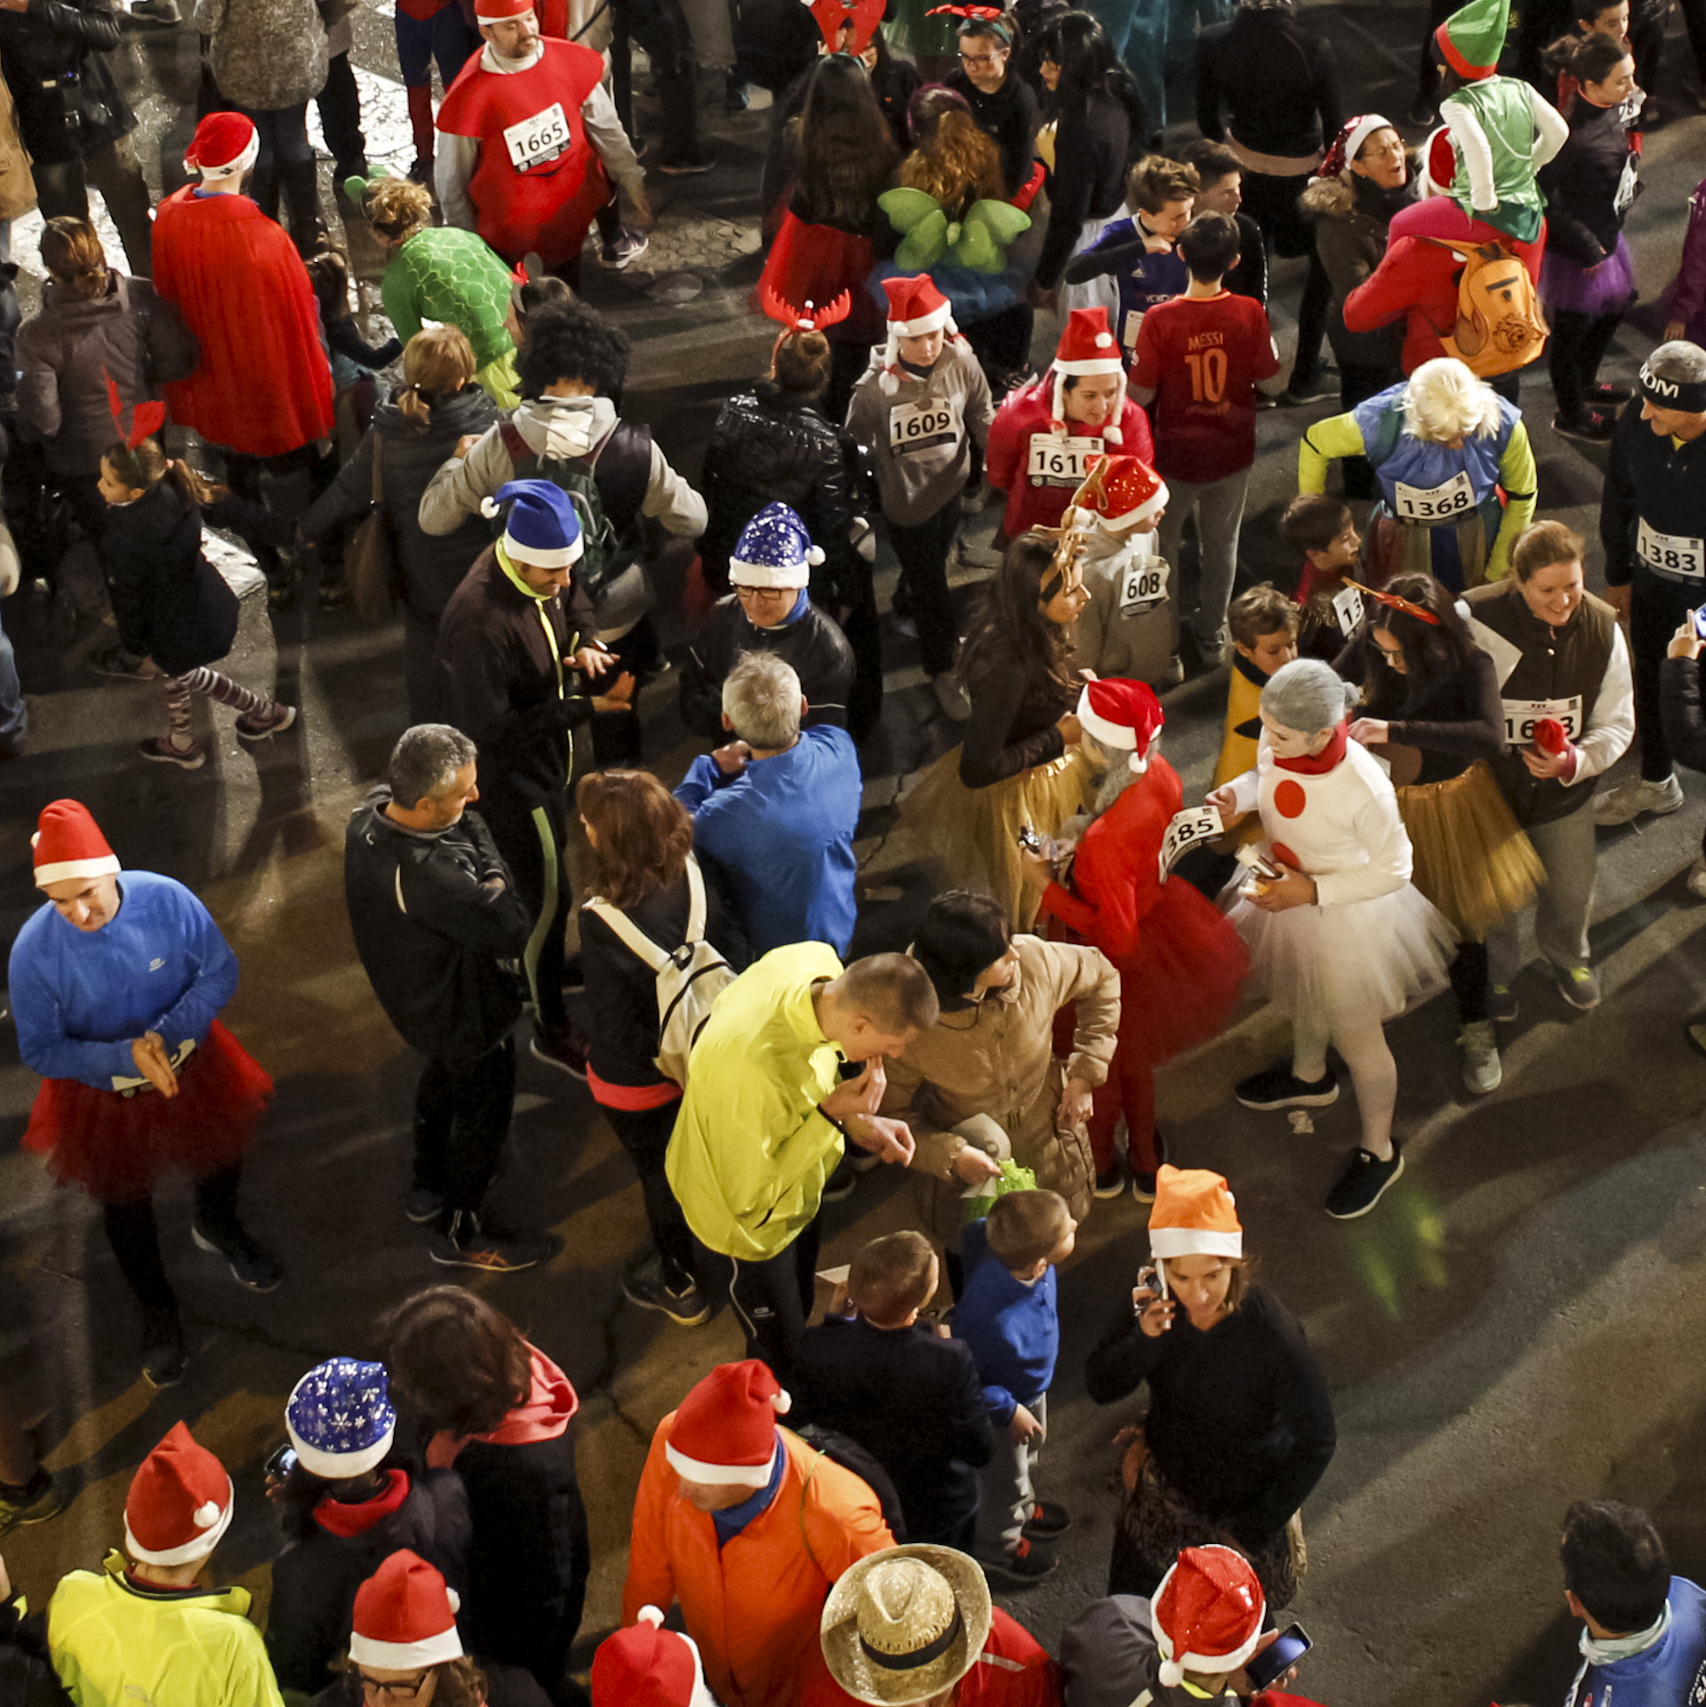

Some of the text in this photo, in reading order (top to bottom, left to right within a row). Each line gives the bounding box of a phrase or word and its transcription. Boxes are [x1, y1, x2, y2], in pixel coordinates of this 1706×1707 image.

[515, 124, 563, 158] 1665
[1188, 332, 1224, 351] MESSI
[1185, 348, 1228, 403] 10
[894, 412, 950, 440] 1609
[1035, 451, 1078, 474] 161
[1405, 490, 1468, 517] 1368
[1641, 537, 1697, 573] 1383
[1505, 716, 1574, 740] 163
[1169, 819, 1214, 856] 385
